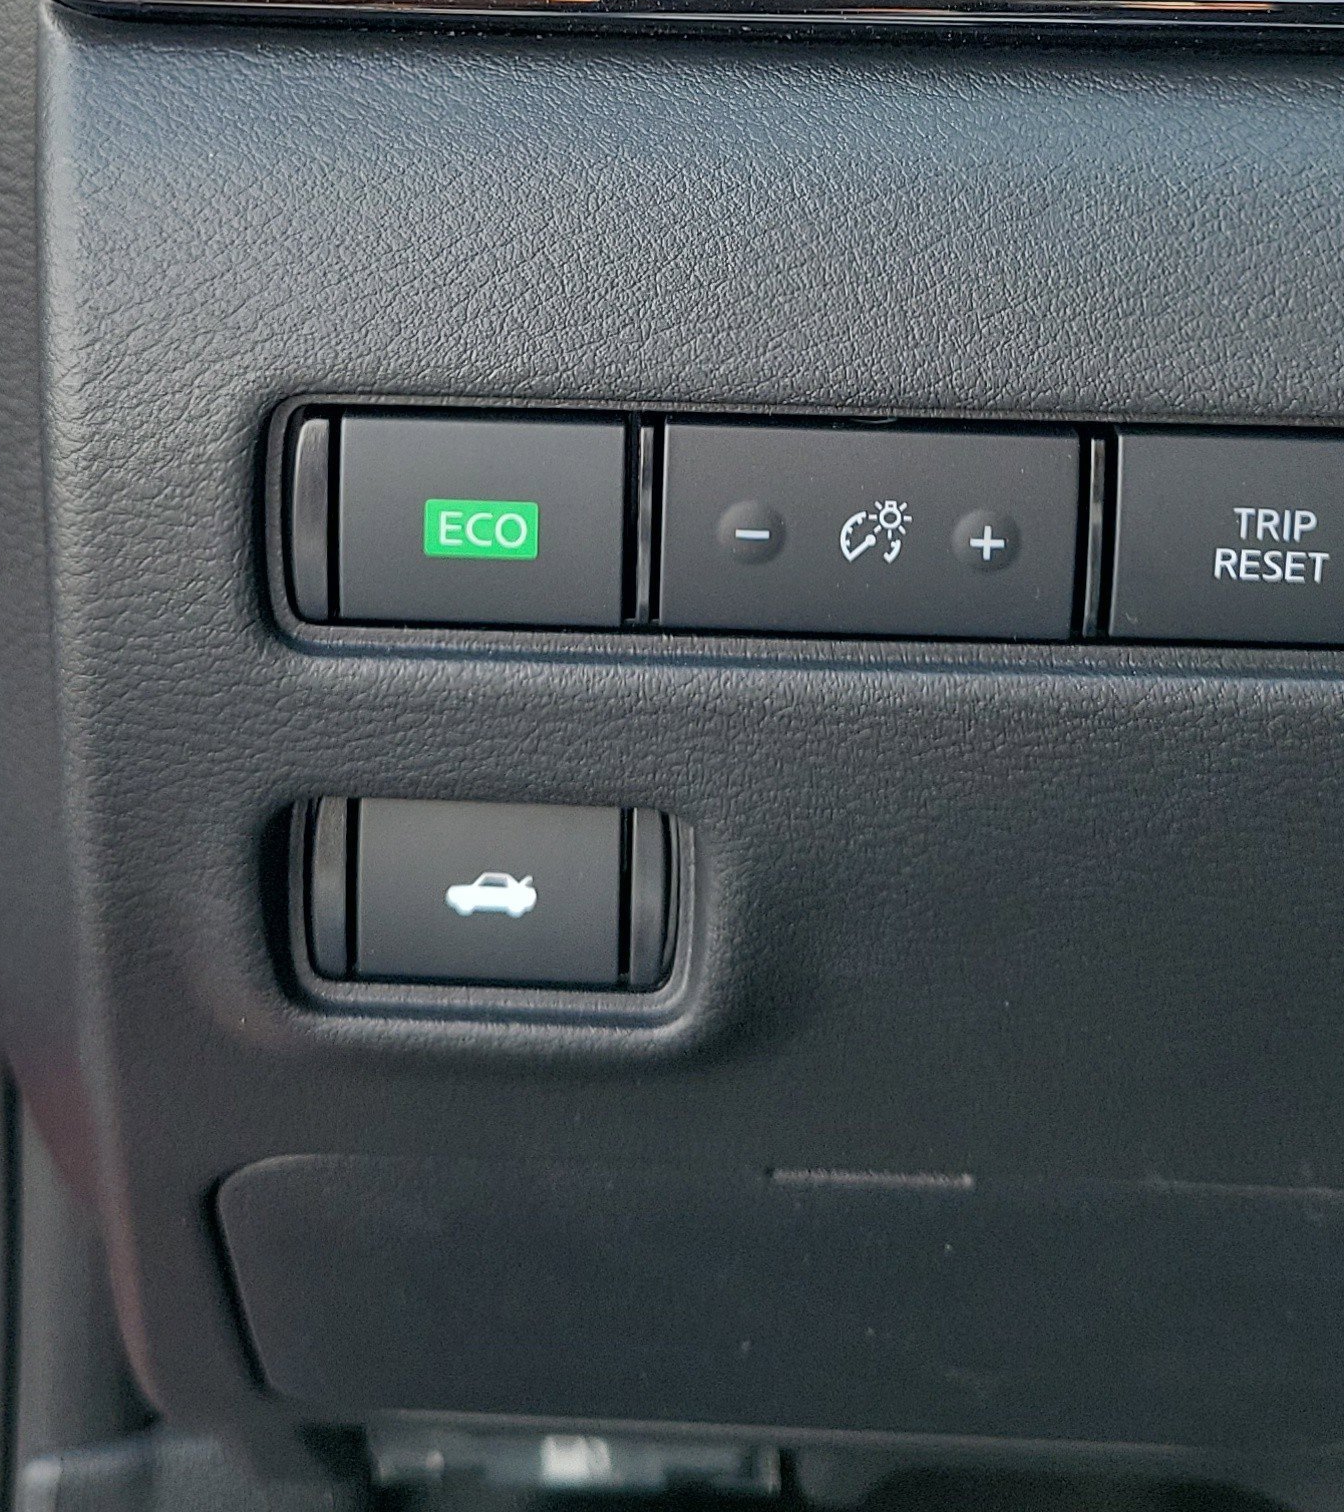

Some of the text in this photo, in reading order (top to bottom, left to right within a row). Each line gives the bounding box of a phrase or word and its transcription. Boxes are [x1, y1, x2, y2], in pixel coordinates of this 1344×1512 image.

[439, 510, 528, 549] ECO
[1233, 507, 1318, 543] TRIP
[1213, 548, 1331, 585] RESET
